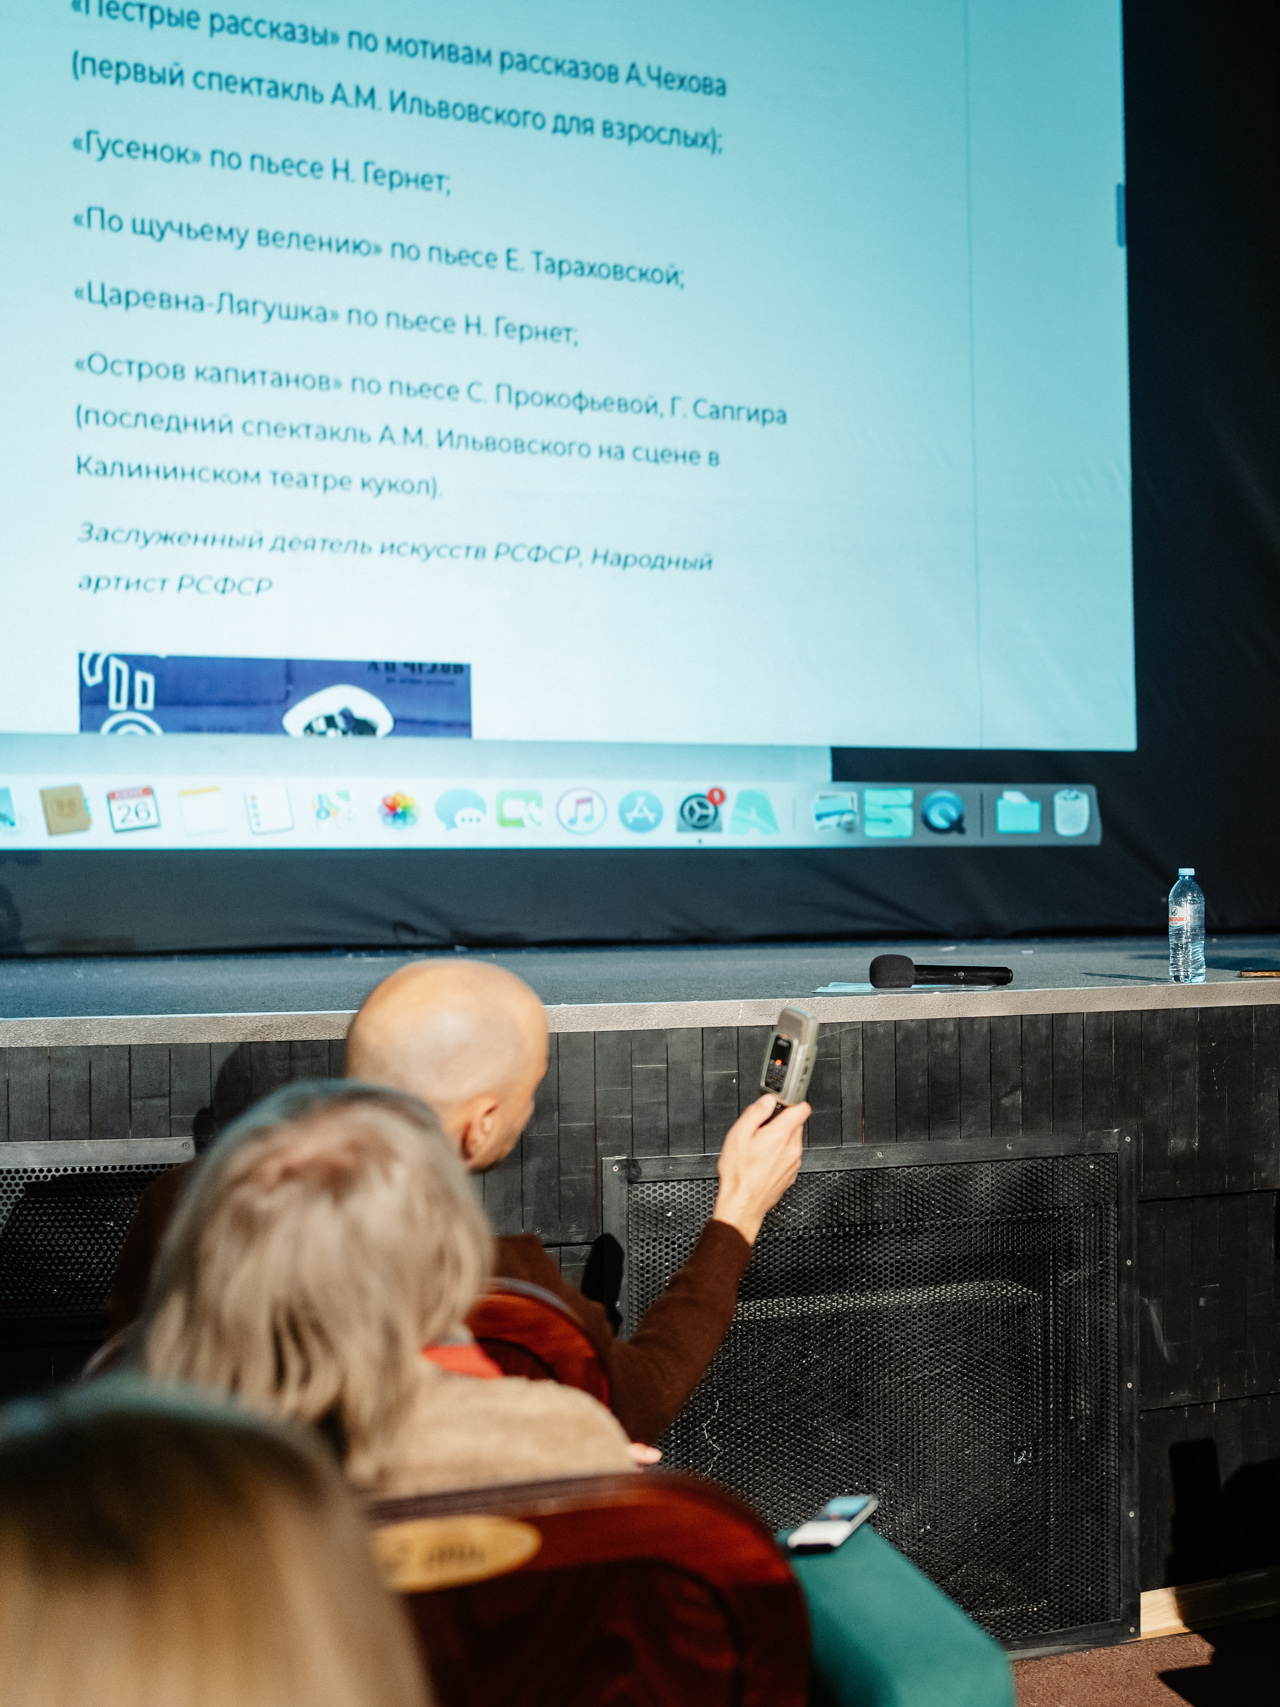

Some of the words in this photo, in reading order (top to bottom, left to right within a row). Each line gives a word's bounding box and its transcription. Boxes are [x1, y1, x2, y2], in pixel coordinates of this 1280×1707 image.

[208, 11, 341, 47] рассказы»
[346, 29, 379, 54] по
[385, 35, 493, 68] мотивам
[498, 49, 620, 85] рассказов
[625, 61, 728, 98] А.Чехова
[71, 48, 185, 89] (первый
[191, 69, 325, 105] спектакль
[330, 81, 382, 112] А.М.
[388, 88, 547, 132] Ильвовского
[550, 112, 596, 138] для
[601, 118, 723, 157] взрослых);
[71, 128, 202, 166] «Гусенок»
[209, 148, 243, 171] по
[249, 152, 325, 181] пьесе
[331, 157, 356, 183] Н.
[362, 159, 451, 198] Гернет;
[72, 204, 124, 234] «По
[130, 215, 250, 251] щучьему
[256, 227, 383, 258] велению»
[390, 240, 422, 262] по
[427, 244, 499, 270] пьесе
[505, 246, 525, 272] Е.
[530, 249, 685, 291] Тараховской;
[73, 279, 340, 325] «Царевна-Лягушка»
[346, 307, 379, 328] по
[385, 310, 457, 335] пьесе
[464, 313, 487, 337] Н.
[494, 315, 579, 348] Гернет;
[74, 350, 186, 383] «Остров
[194, 365, 343, 392] капитанов»
[350, 375, 382, 396] по
[388, 379, 460, 402] пьесе
[466, 380, 487, 403] С.
[495, 381, 664, 419] Прокофьевой,
[670, 395, 686, 417] Г.
[692, 397, 788, 429] Сапгира
[75, 402, 234, 435] (последний
[241, 419, 372, 444] спектакль
[378, 424, 428, 448] А.М.
[436, 427, 592, 459] Ильвовского
[597, 443, 626, 461] на
[631, 445, 702, 466] сцене
[707, 450, 721, 468] в
[75, 453, 262, 486] Калининском
[268, 469, 353, 495] театре
[77, 521, 264, 550] Заслуженный
[268, 535, 373, 555] деятель
[379, 541, 488, 563] искусств
[493, 541, 583, 568] РСФСР,
[590, 547, 714, 572] Народный
[77, 574, 170, 595] артист
[176, 573, 273, 596] РСФСР
[117, 801, 151, 824] 26
